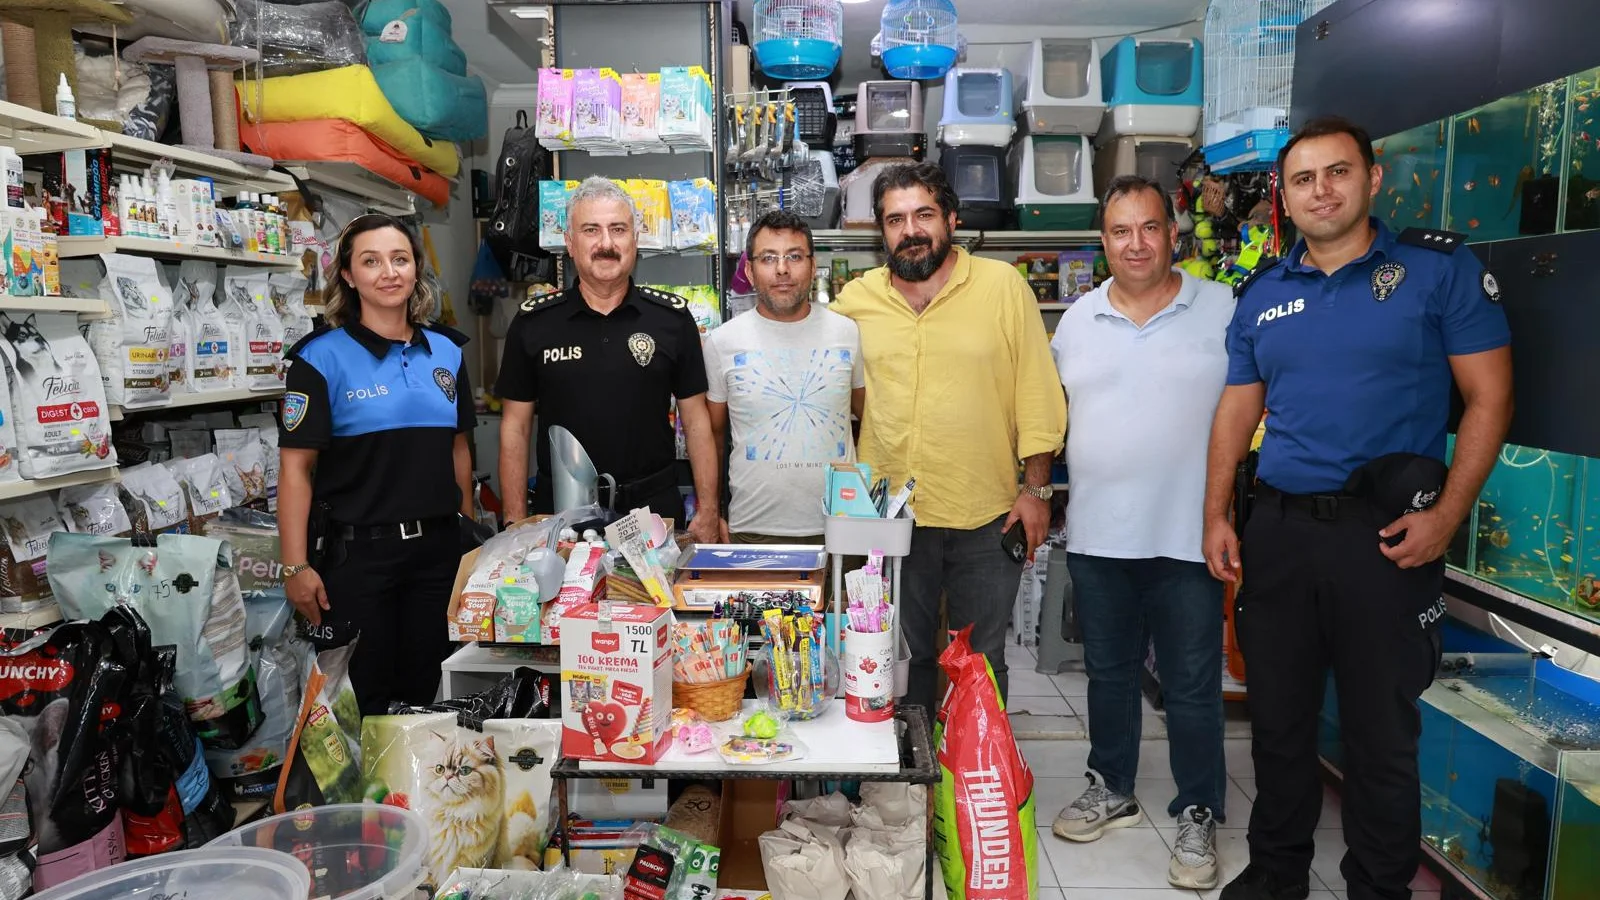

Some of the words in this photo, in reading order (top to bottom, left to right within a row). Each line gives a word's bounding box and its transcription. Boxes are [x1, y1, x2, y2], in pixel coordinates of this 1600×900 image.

[43, 376, 80, 401] Felicia
[347, 384, 389, 402] POLİS
[41, 408, 69, 419] DIGEST
[618, 530, 629, 539] 20
[625, 625, 652, 635] 1500
[630, 639, 648, 653] TL
[578, 654, 595, 664] 100
[598, 656, 639, 667] KREMA
[963, 764, 1010, 890] THUNDER
